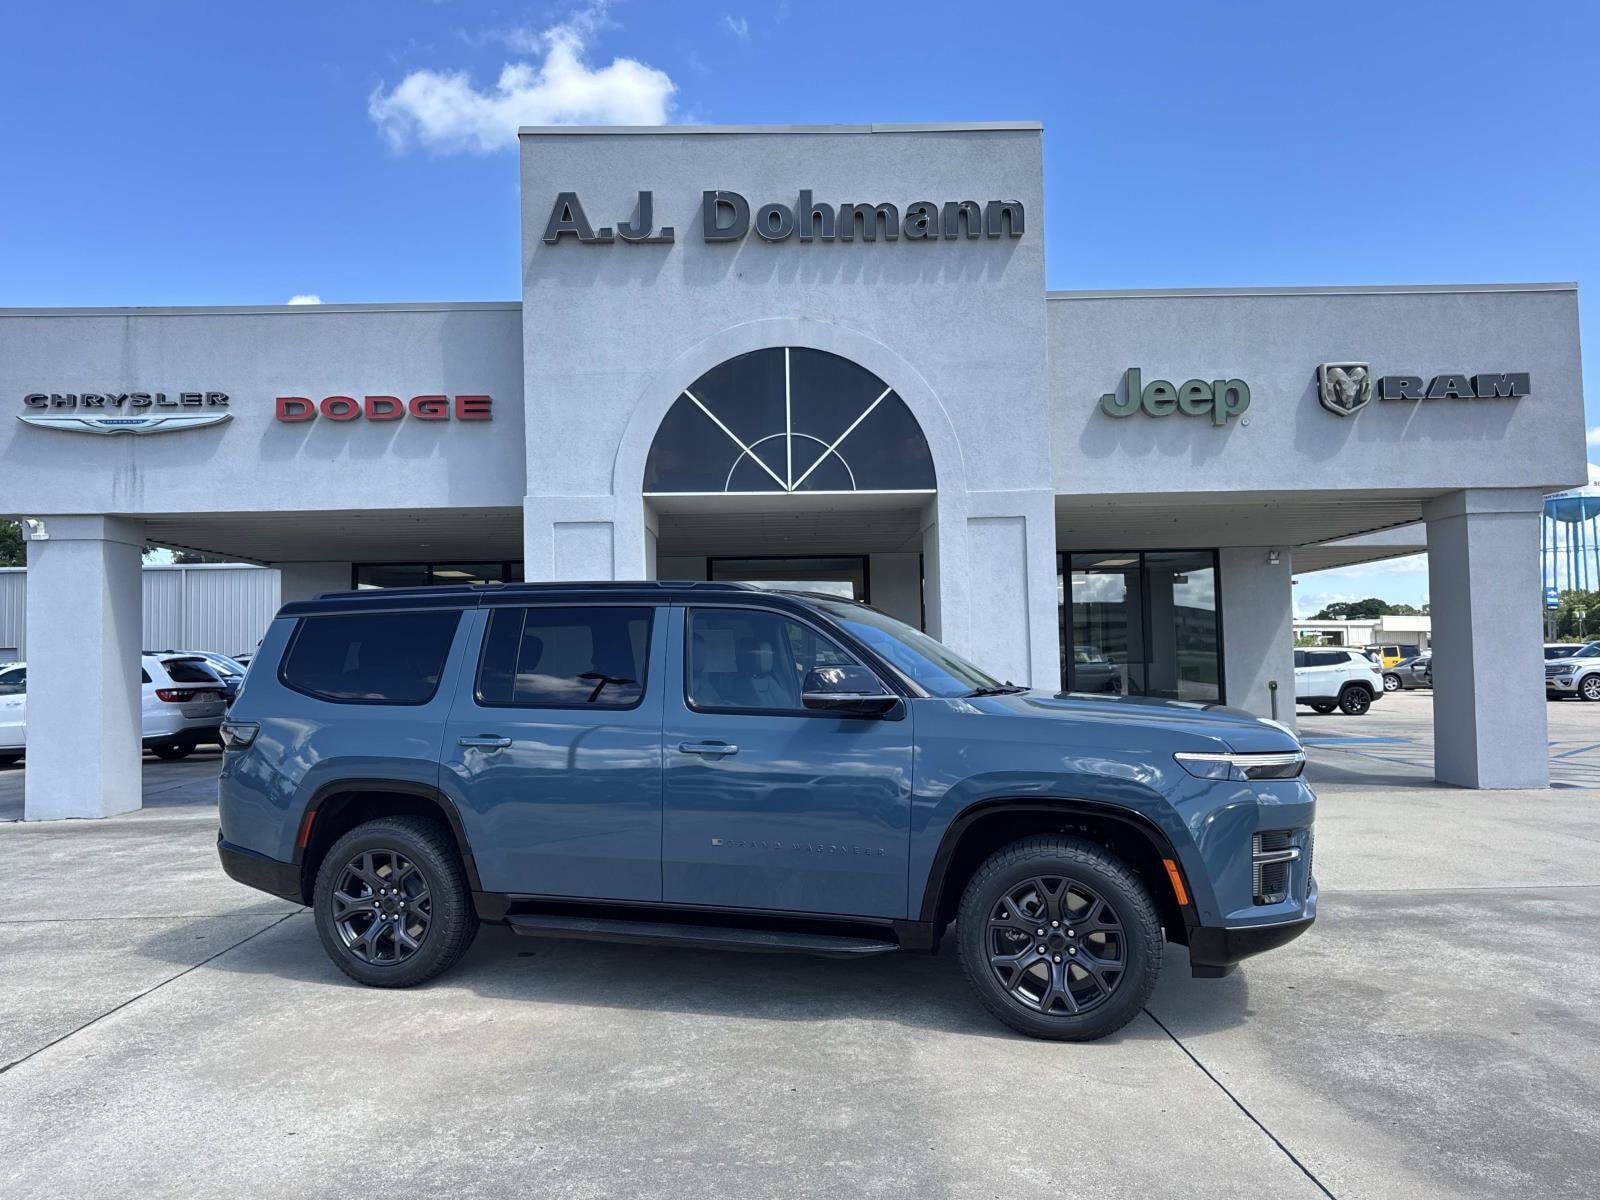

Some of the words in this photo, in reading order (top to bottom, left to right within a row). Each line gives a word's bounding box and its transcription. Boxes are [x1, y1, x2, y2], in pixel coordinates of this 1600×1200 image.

[542, 190, 675, 243] A.J.
[702, 188, 1025, 243] Dohmann
[23, 391, 230, 408] CHRYSLER
[1101, 367, 1251, 427] Jeep
[1378, 372, 1531, 401] RAM
[275, 395, 493, 421] DODGE
